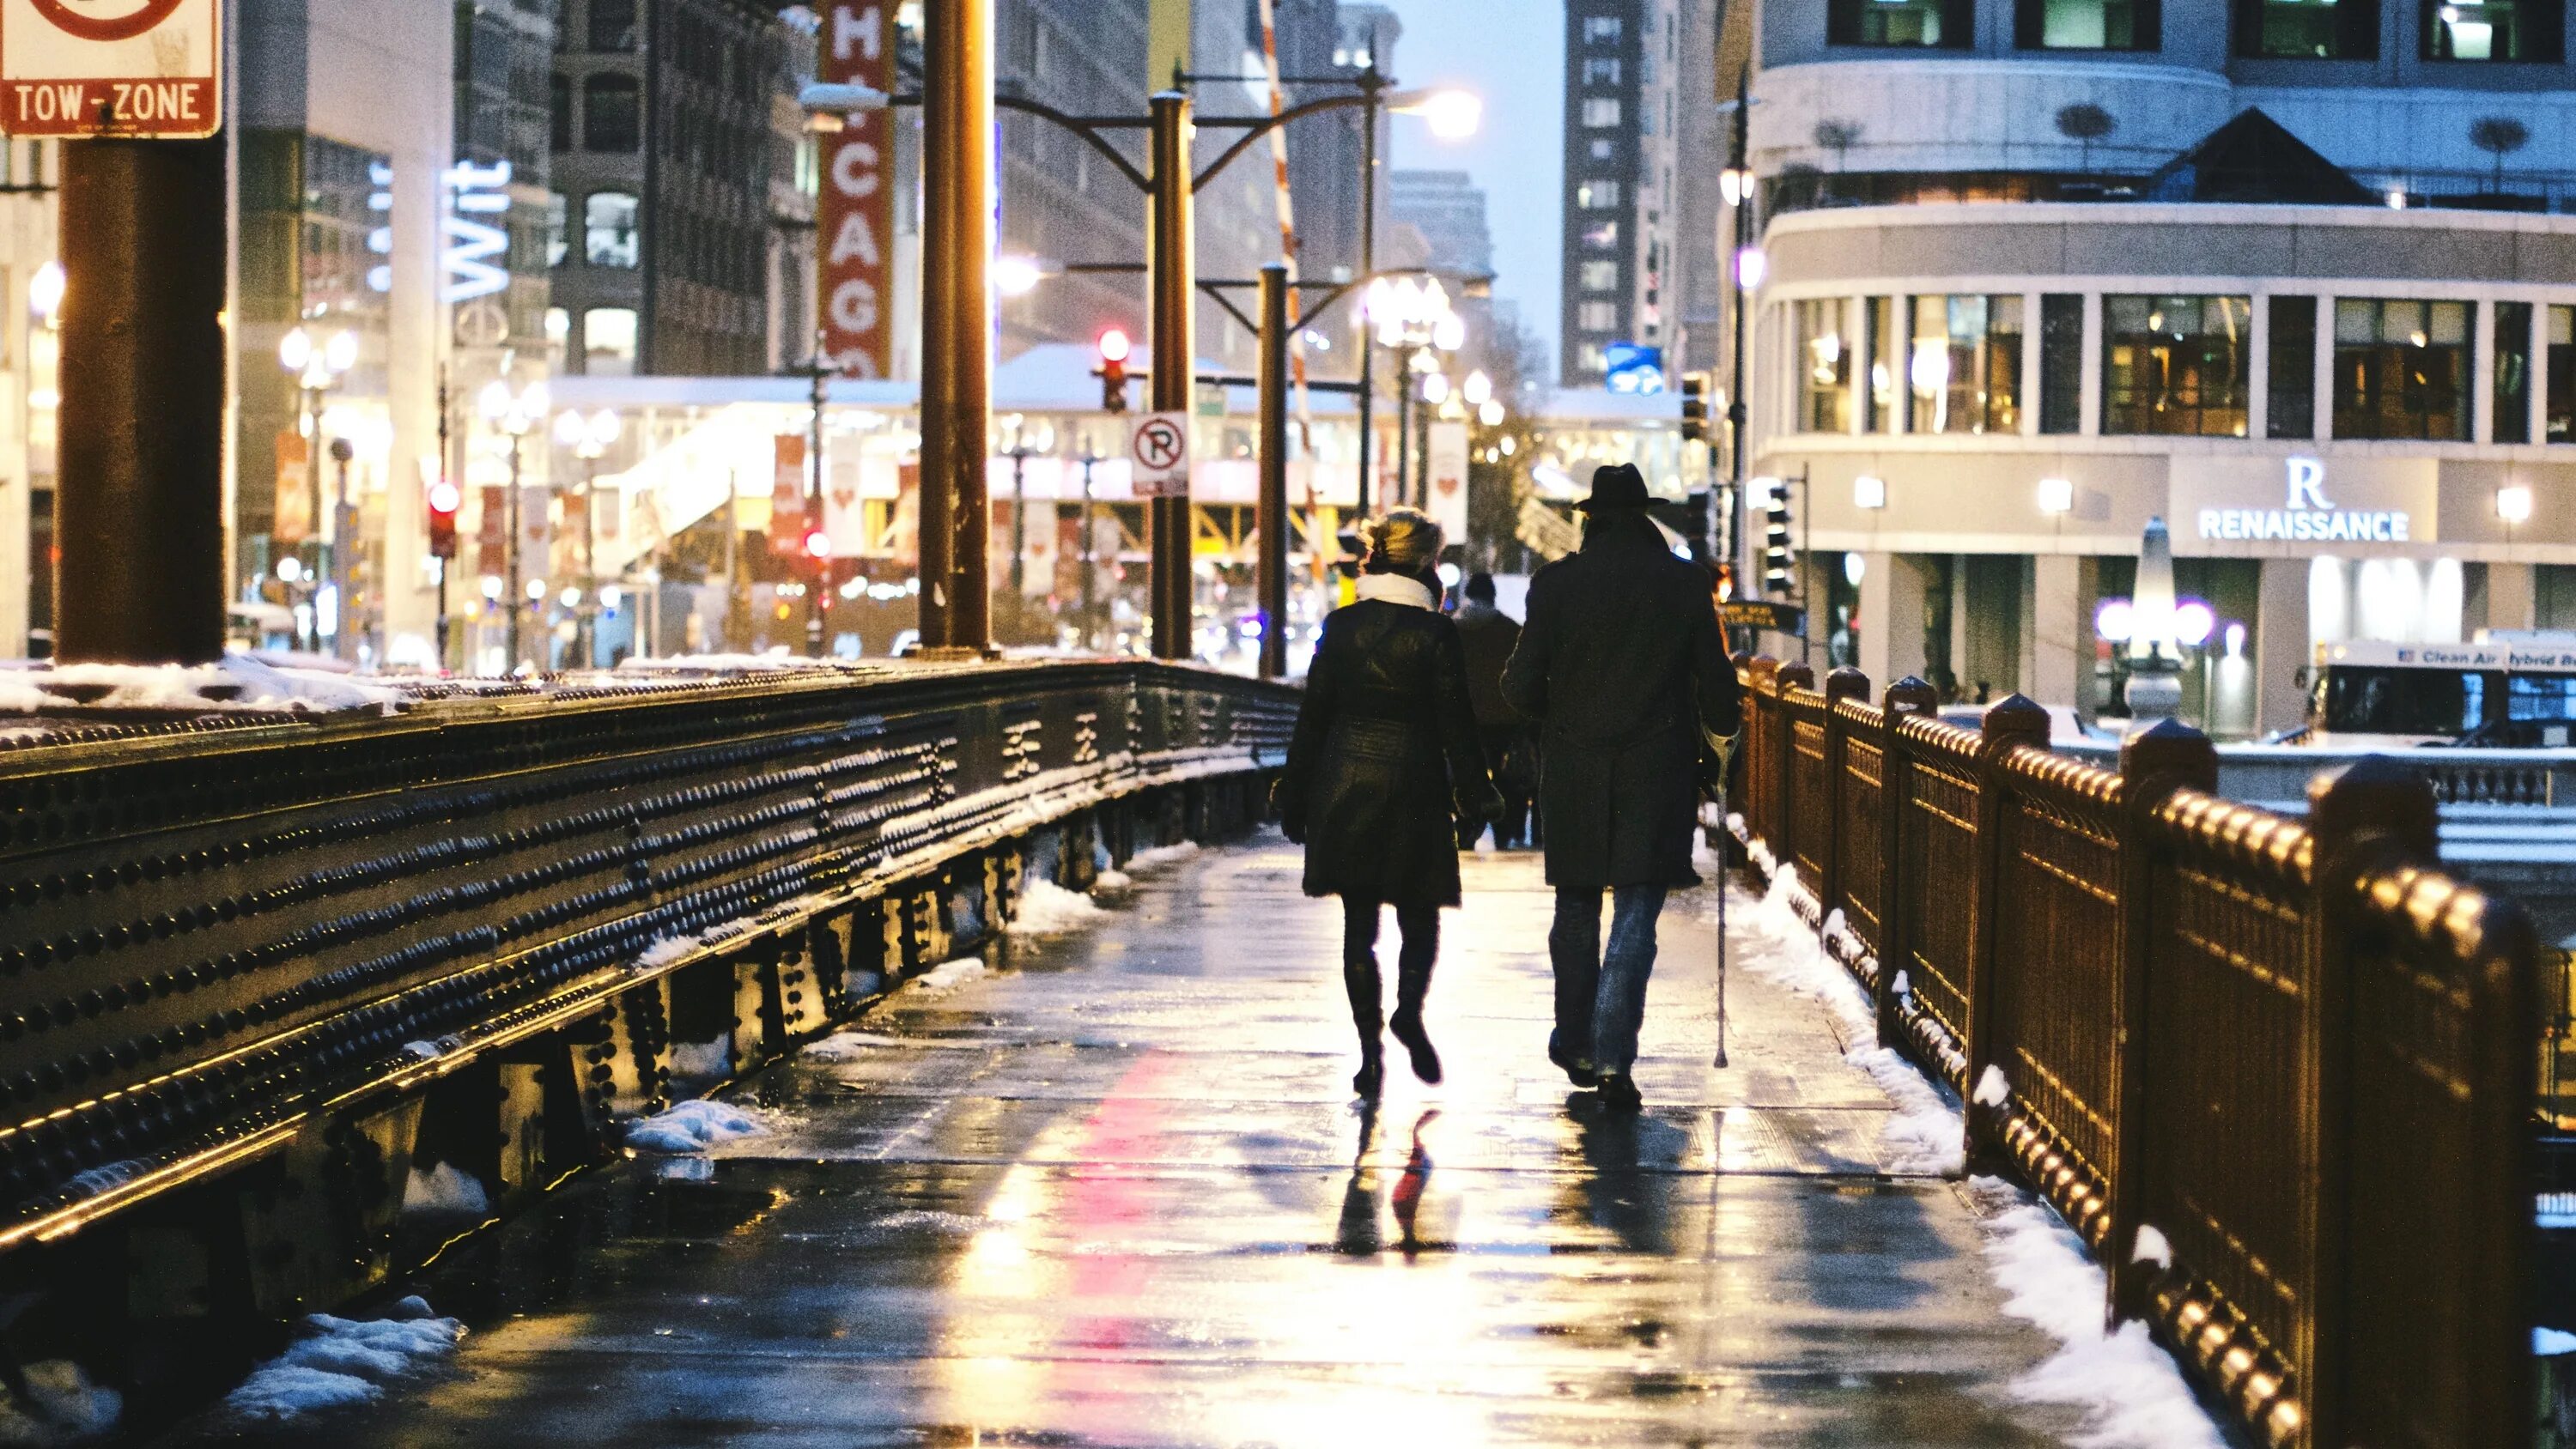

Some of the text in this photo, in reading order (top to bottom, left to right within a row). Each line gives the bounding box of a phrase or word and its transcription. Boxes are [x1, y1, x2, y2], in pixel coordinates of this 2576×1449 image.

[2286, 457, 2335, 509] R
[2198, 511, 2409, 541] RENAISSANCE
[2423, 650, 2469, 664] Clean
[2474, 652, 2496, 664] Air
